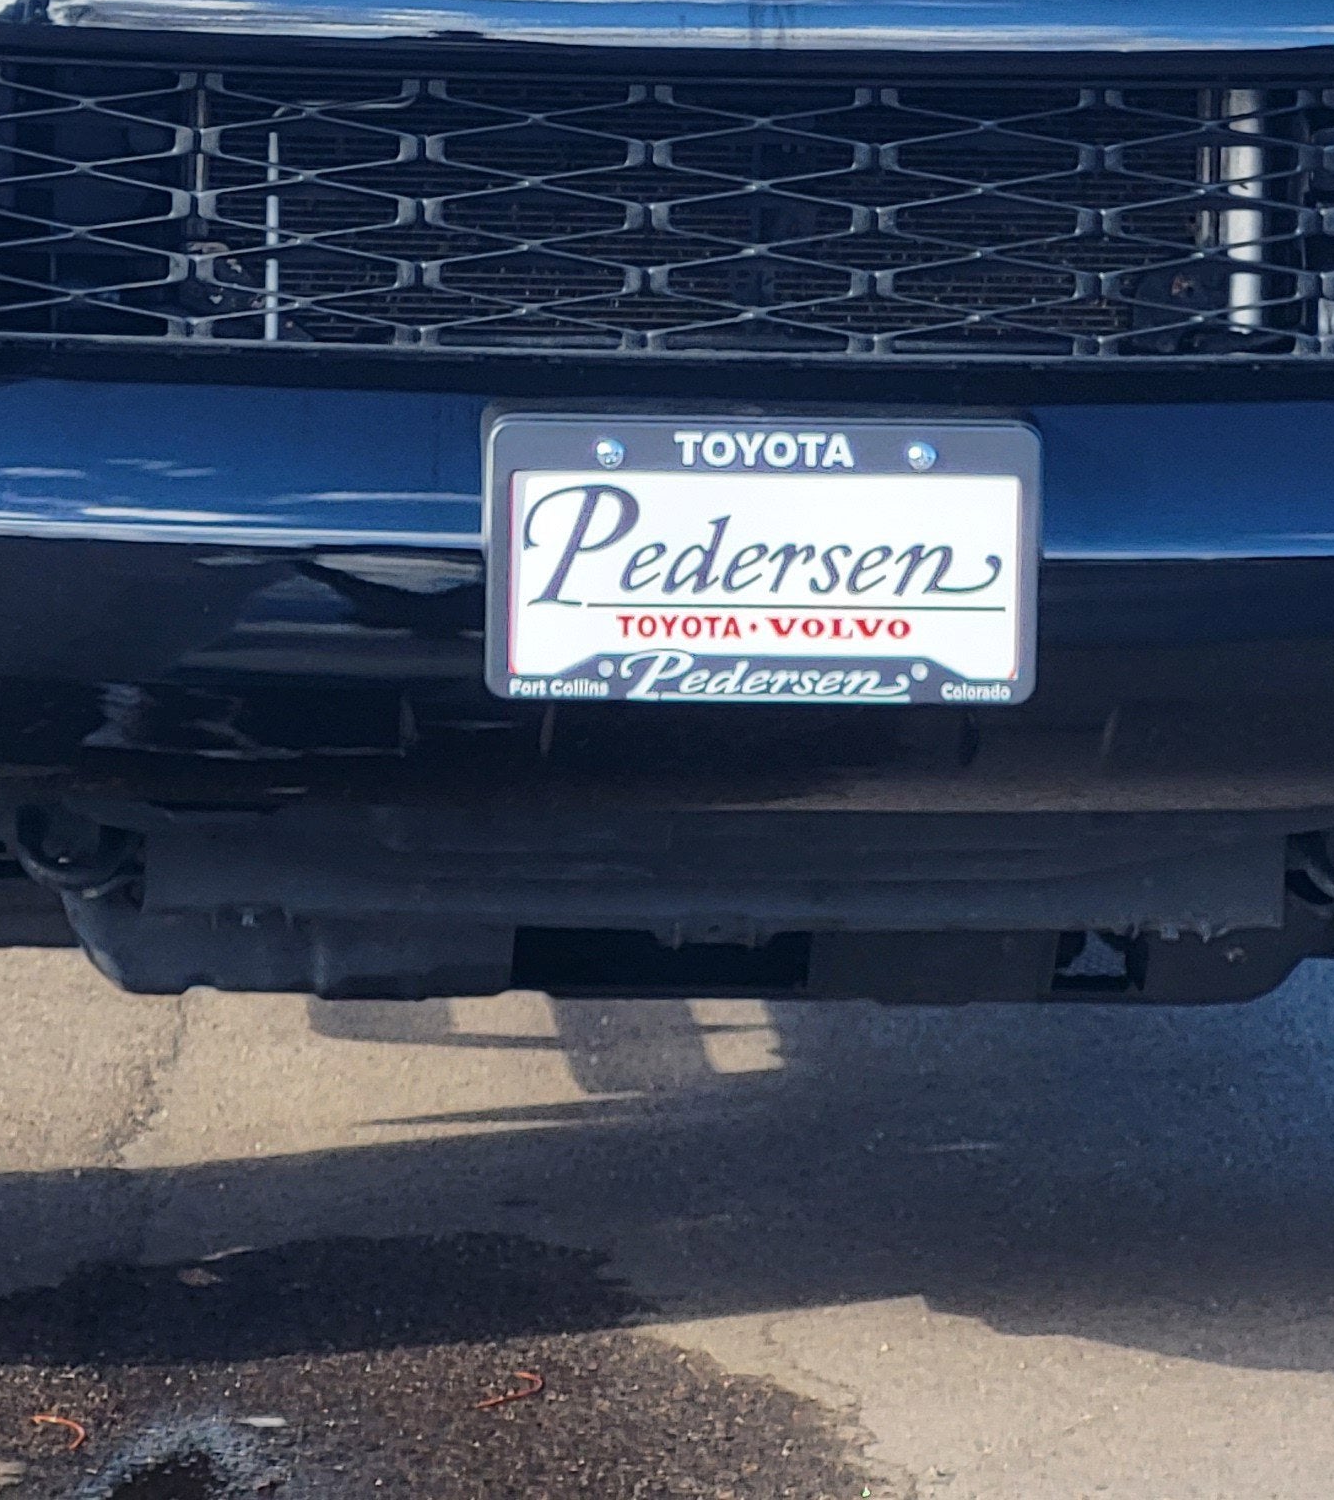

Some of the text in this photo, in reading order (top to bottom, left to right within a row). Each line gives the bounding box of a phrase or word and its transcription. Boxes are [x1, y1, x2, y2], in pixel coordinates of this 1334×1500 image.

[674, 431, 854, 469] TOYOTA
[523, 484, 1002, 606] Pedersen
[617, 615, 912, 639] TOYOTA VOLVO
[508, 677, 610, 697] Fort Collins
[620, 648, 911, 700] Pedersen
[940, 681, 1012, 701] Colorado
